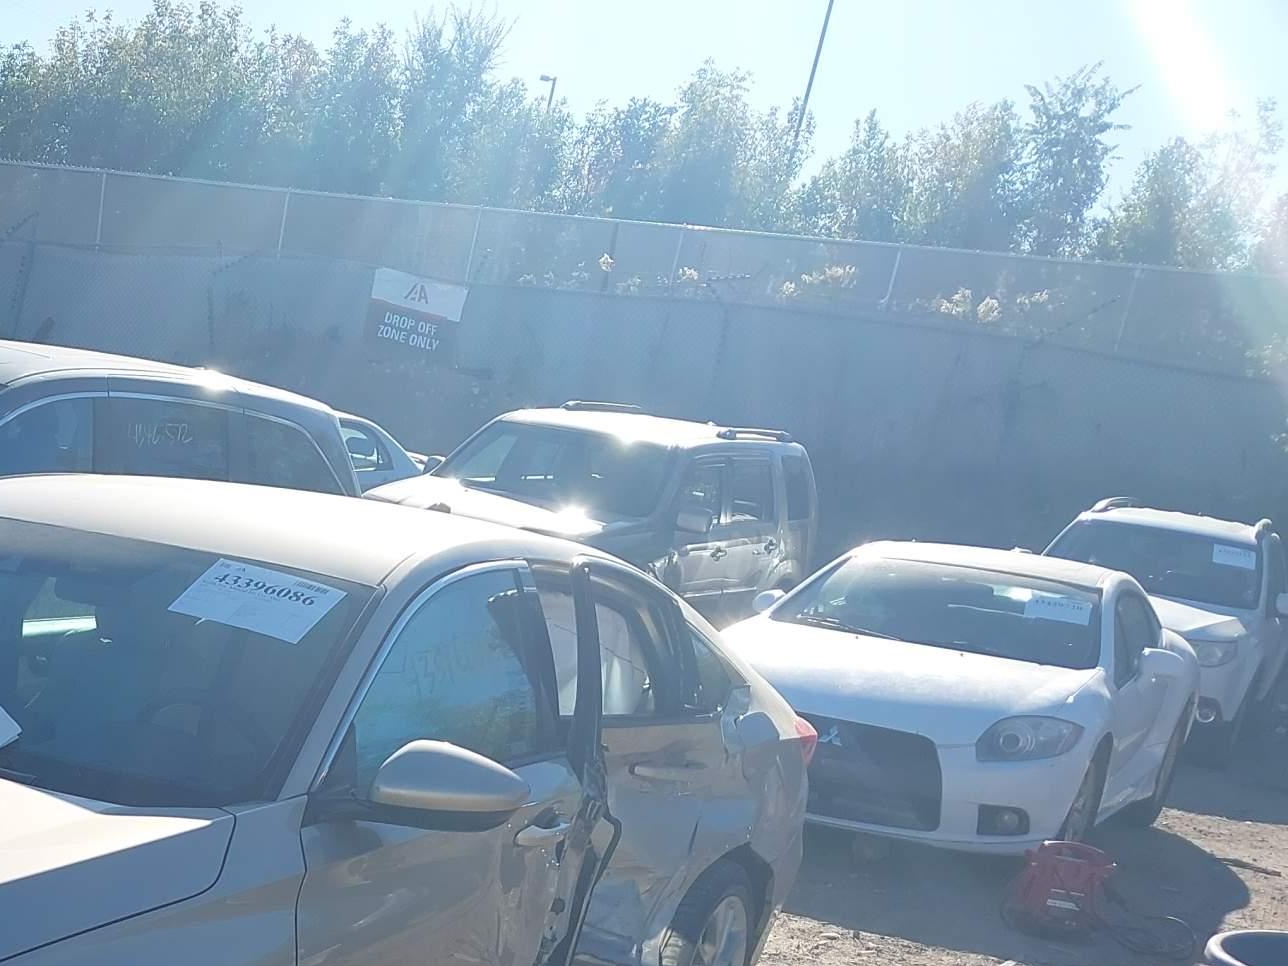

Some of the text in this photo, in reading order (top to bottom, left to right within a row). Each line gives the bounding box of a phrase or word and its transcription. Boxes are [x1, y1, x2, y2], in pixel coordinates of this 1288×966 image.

[384, 311, 438, 336] DROP OFF
[377, 324, 440, 351] ZONE ONLY
[214, 572, 315, 606] 43396086
